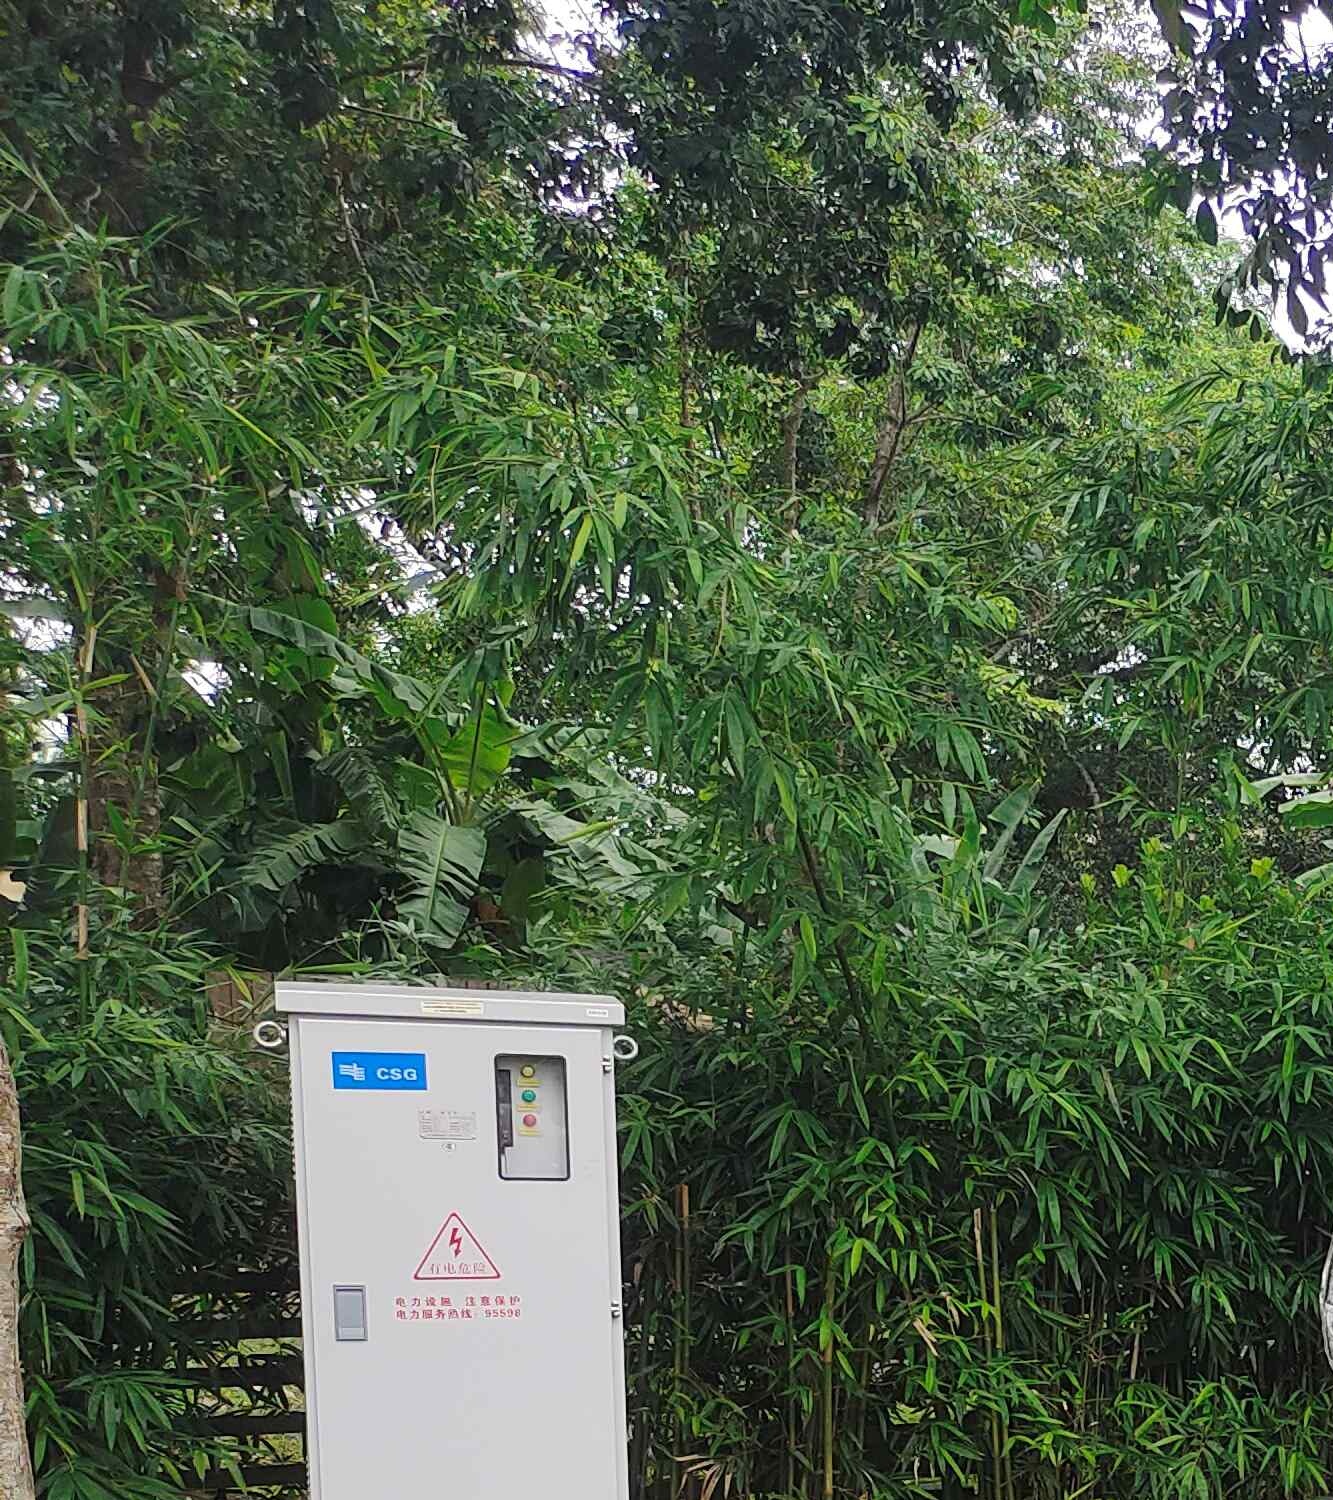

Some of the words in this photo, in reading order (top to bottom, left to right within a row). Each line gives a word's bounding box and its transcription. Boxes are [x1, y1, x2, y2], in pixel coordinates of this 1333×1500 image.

[377, 1067, 417, 1081] CSG
[465, 1296, 520, 1307] 注意保护
[396, 1308, 473, 1320] 电力服务热线
[484, 1309, 520, 1318] 95598
